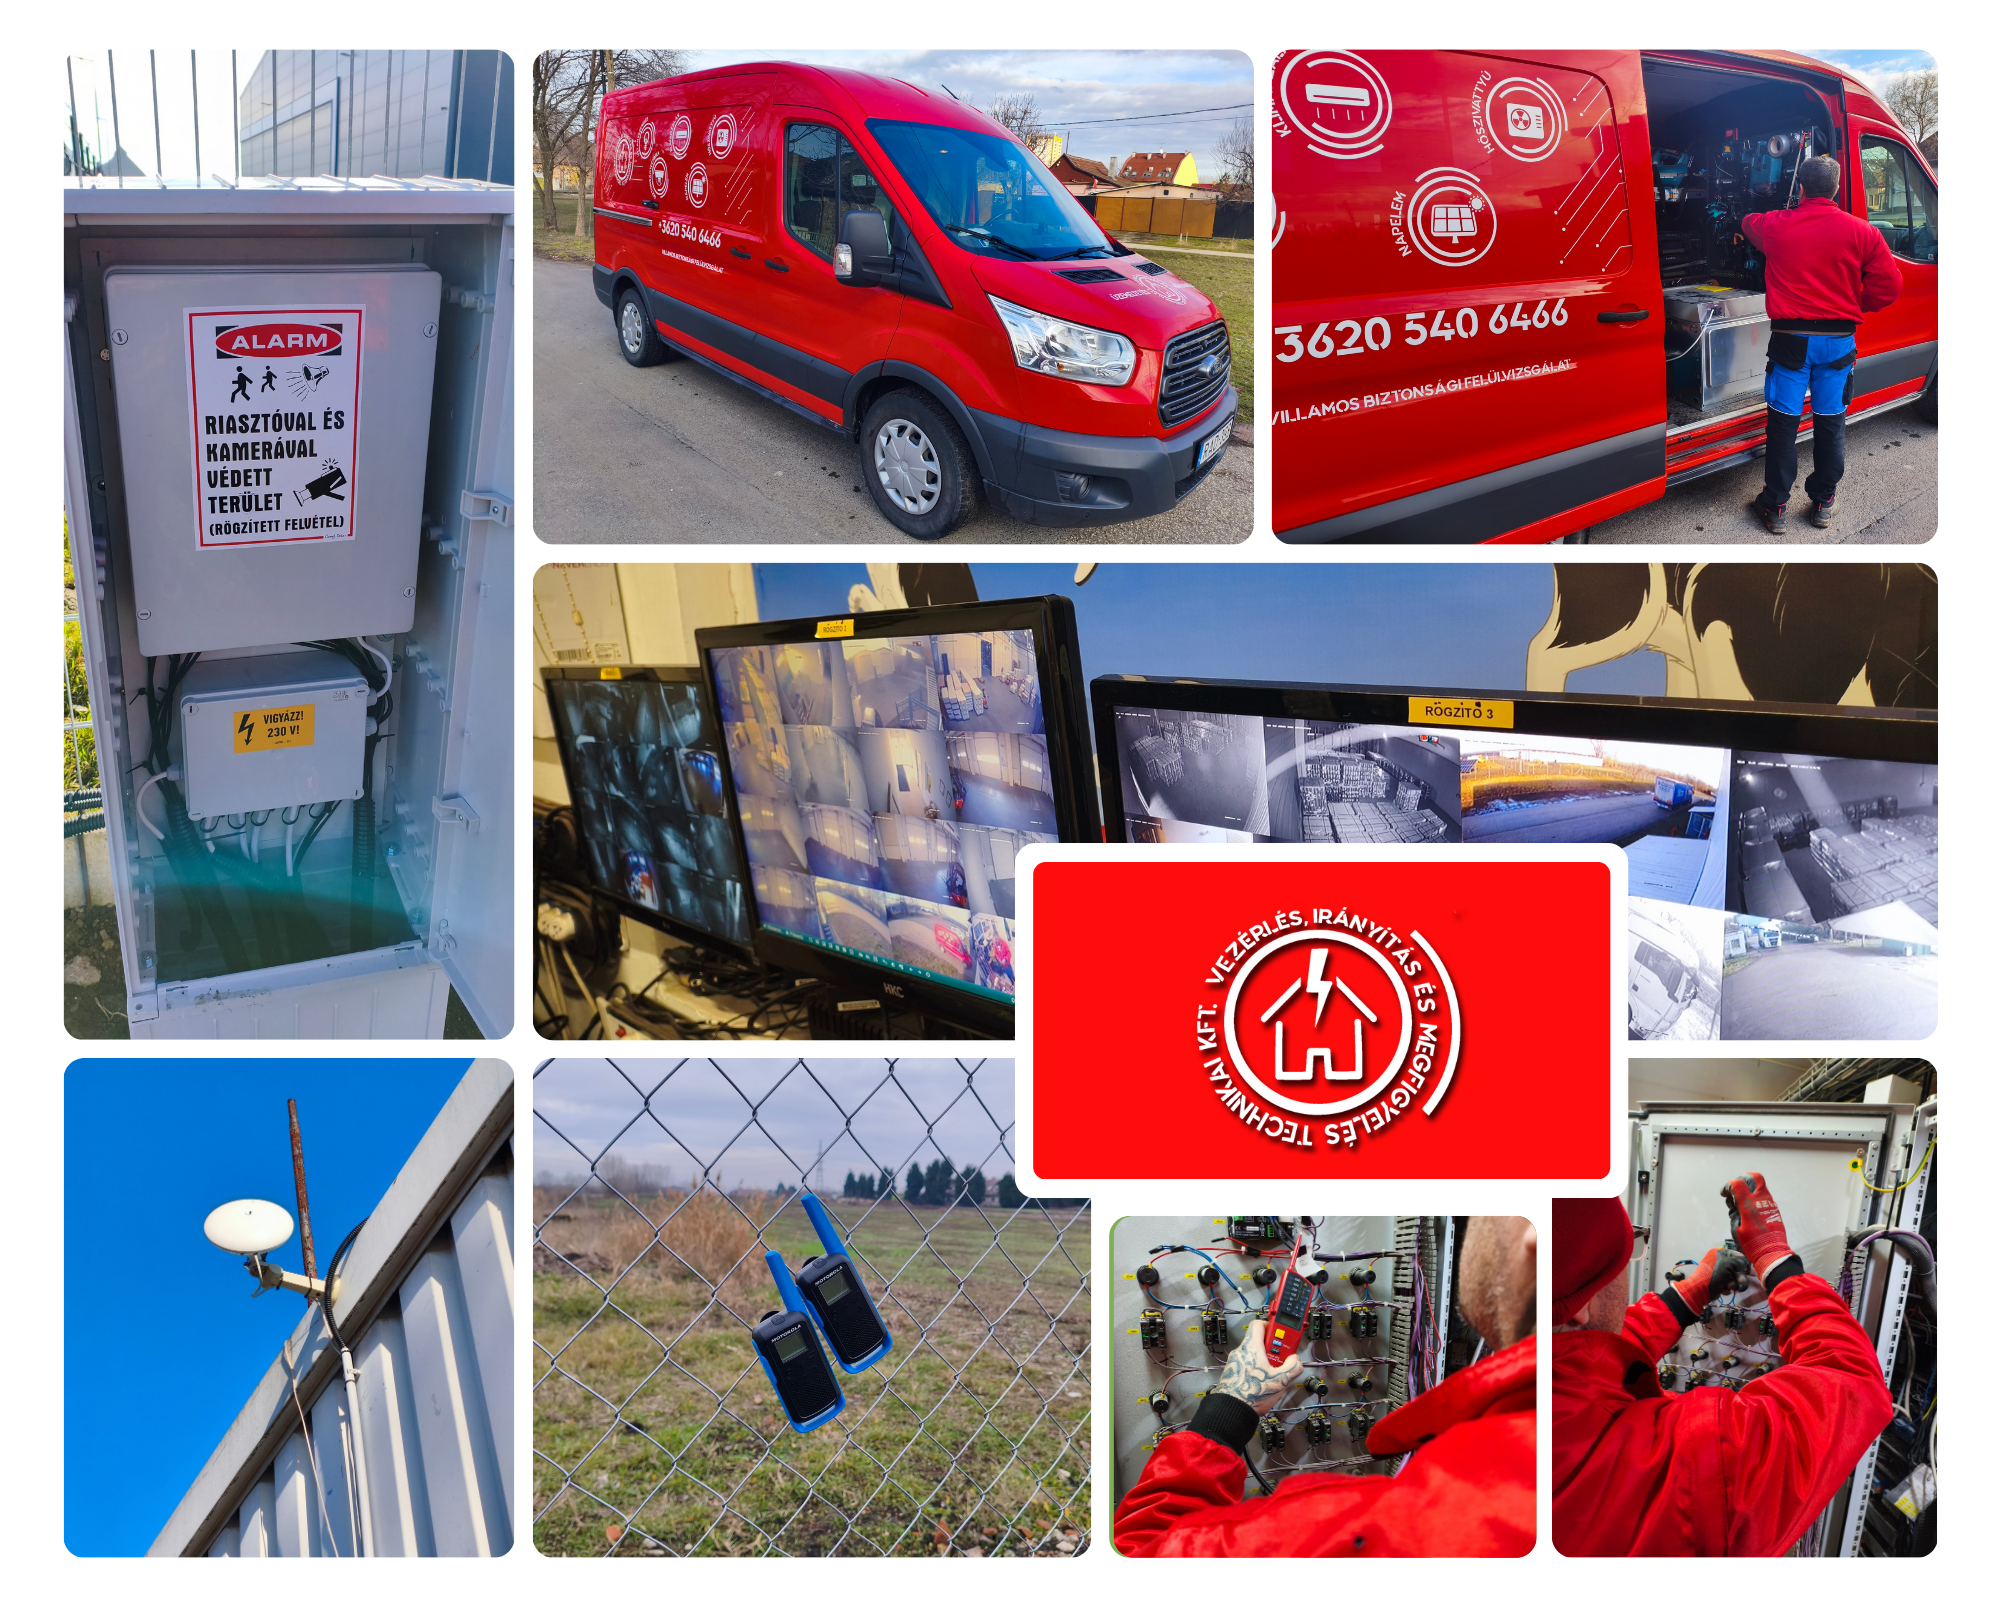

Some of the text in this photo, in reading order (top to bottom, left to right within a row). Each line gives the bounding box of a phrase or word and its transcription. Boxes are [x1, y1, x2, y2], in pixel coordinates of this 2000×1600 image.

[658, 219, 721, 249] +3620 540 6466
[1389, 191, 1412, 258] NAPELEM
[1274, 297, 1569, 363] 3620 540 6466
[231, 333, 328, 350] ALARM
[1363, 380, 1463, 408] BIZTONSÁGI
[1464, 358, 1572, 389] FELÜLVIZSGÁLAT
[205, 407, 345, 435] RIASZTÓVAL ÉS
[206, 437, 318, 462] KAMERÁVAL
[207, 466, 273, 488] VÉDETT
[208, 491, 283, 514] TERÜLET
[209, 515, 344, 536] (RÖGZÍTETT FELVÉTEL)
[263, 709, 304, 724] VIGYÁZZ!
[1486, 708, 1494, 719] 3
[267, 725, 300, 738] 230 V!
[883, 981, 904, 998] HKC
[815, 1265, 843, 1286] MOTOROLA
[771, 1324, 801, 1343] MOTOROLA
